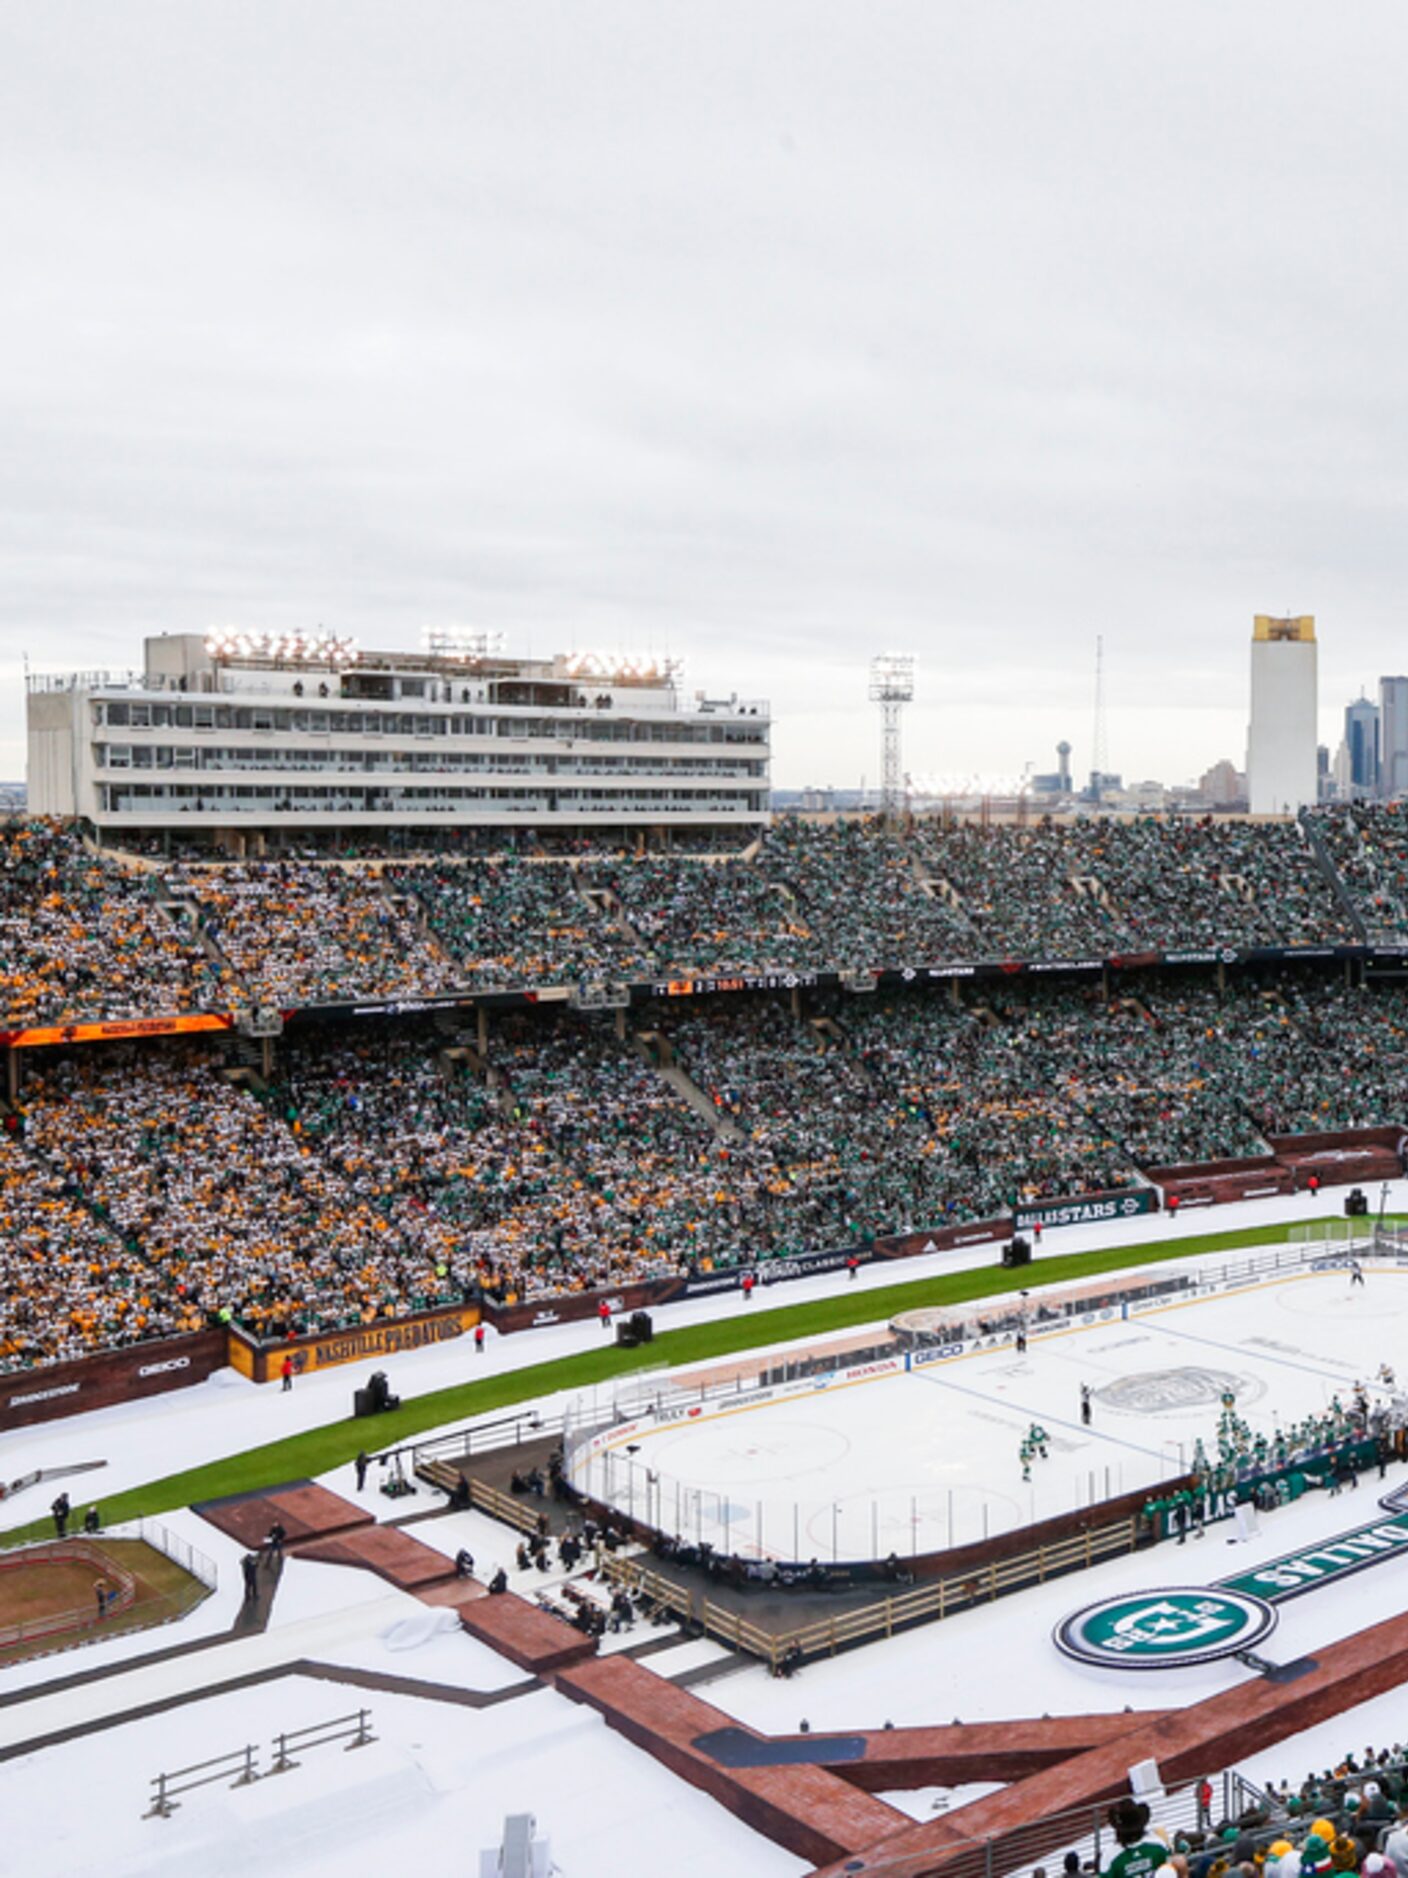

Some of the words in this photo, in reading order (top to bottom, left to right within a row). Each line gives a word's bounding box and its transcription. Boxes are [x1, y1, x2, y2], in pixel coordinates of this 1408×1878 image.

[1058, 1200, 1118, 1224] STARS
[315, 1332, 384, 1366] NASHVILLE
[914, 1343, 964, 1365] GEICO
[138, 1356, 191, 1377] GEICO
[846, 1360, 897, 1379] HONDA
